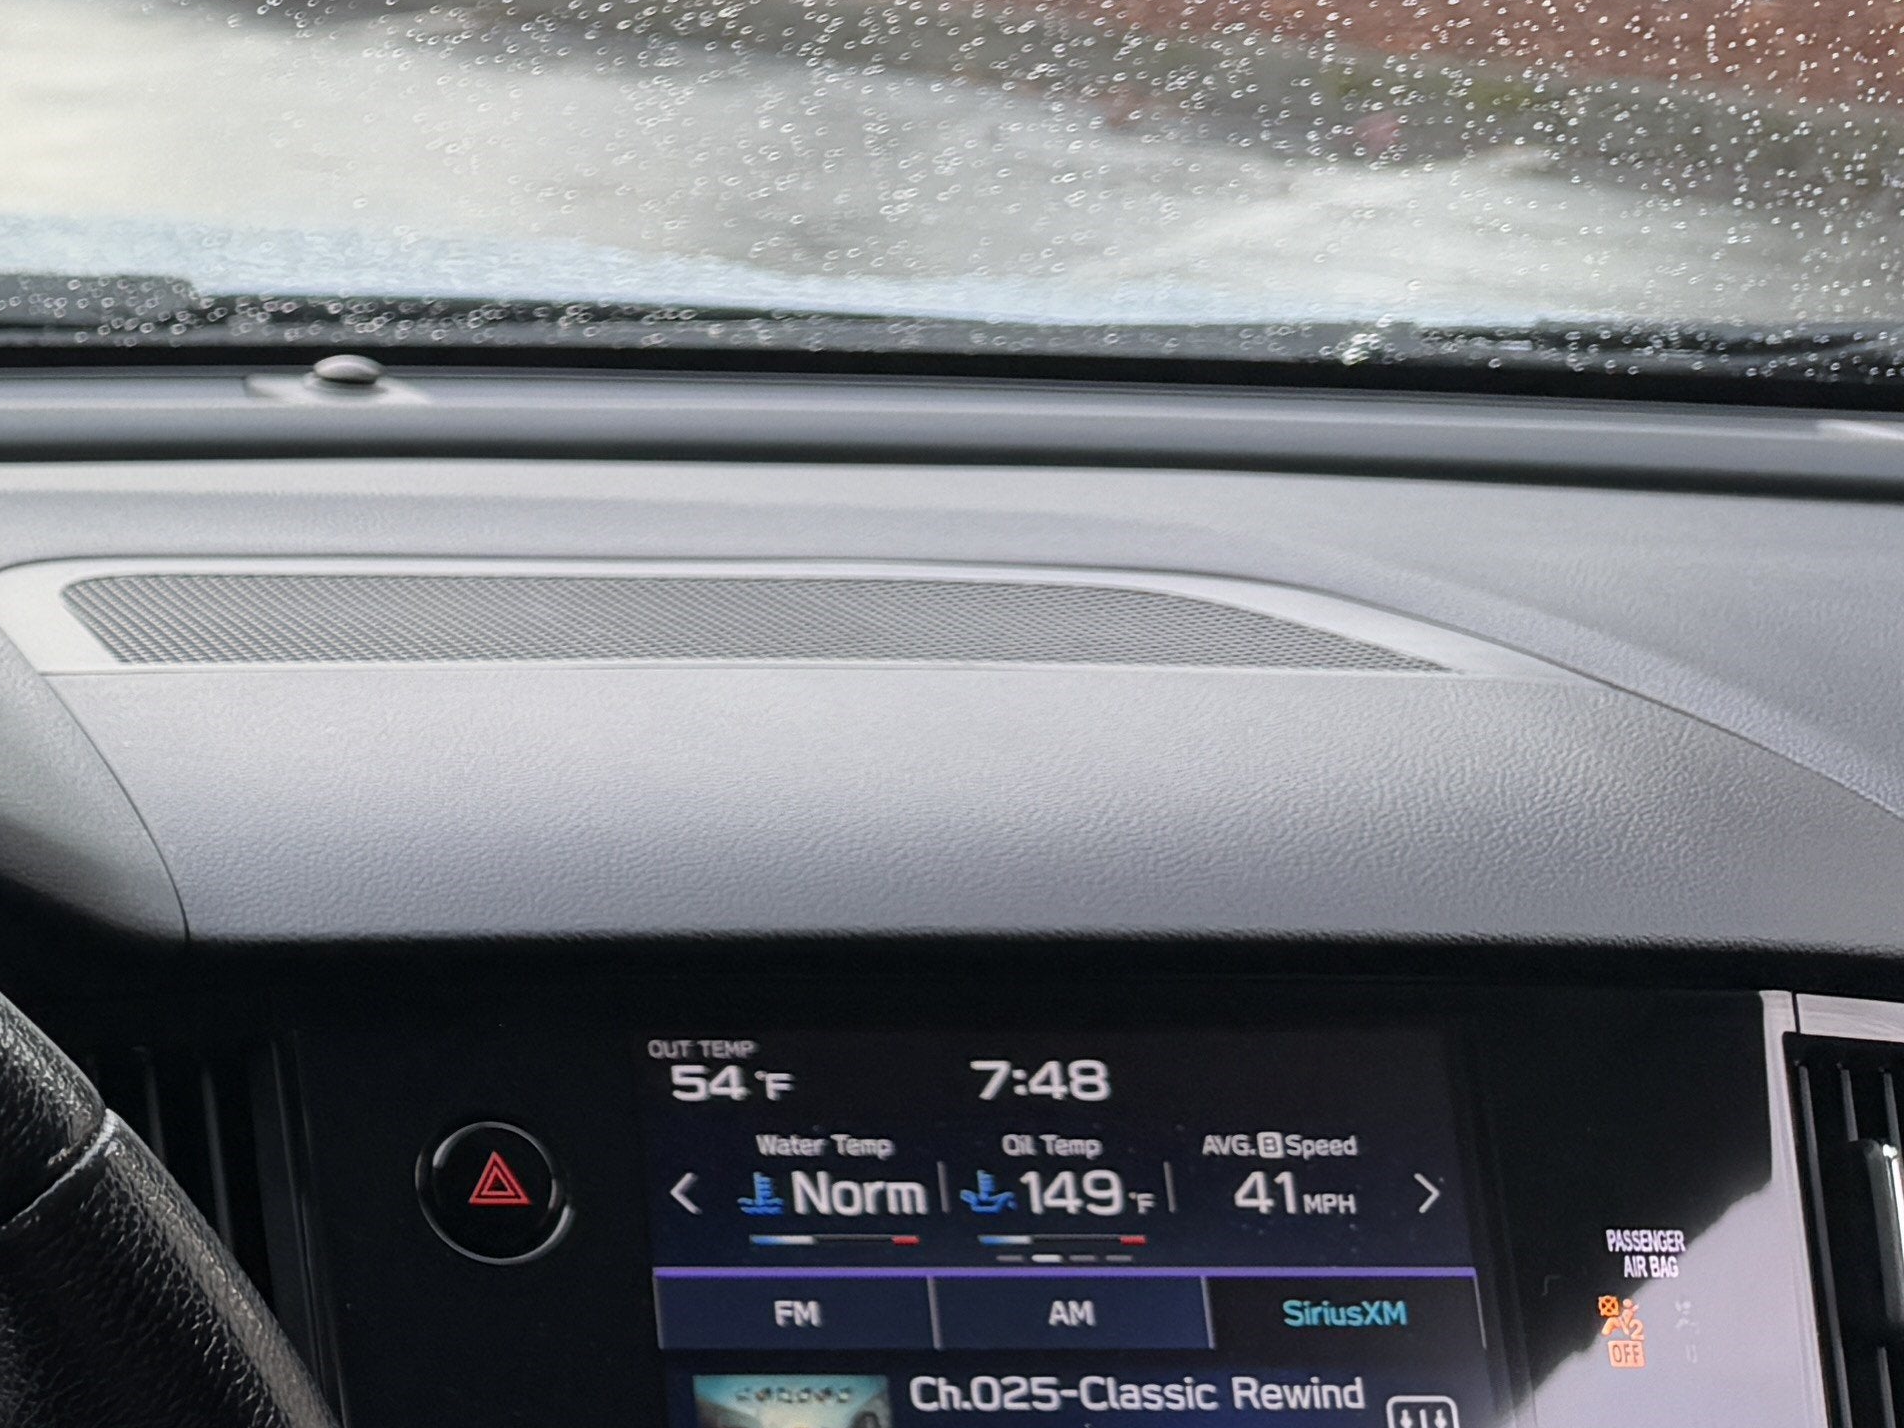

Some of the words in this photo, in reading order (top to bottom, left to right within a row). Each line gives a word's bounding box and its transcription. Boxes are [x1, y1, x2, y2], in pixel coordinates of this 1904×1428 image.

[648, 1040, 692, 1059] OUT
[697, 1040, 758, 1059] TEMP
[671, 1065, 749, 1101] 54
[969, 1060, 1111, 1101] 7:48
[756, 1134, 828, 1156] Water
[831, 1134, 896, 1160] Temp
[1002, 1134, 1037, 1157] Oil
[1042, 1134, 1102, 1159] Temp
[1285, 1134, 1357, 1159] Speed
[793, 1171, 927, 1216] Norm
[1020, 1171, 1127, 1216] 149
[1234, 1171, 1299, 1215] 41
[1303, 1193, 1357, 1215] MPH
[1605, 1229, 1686, 1252] PASSENGER
[1624, 1256, 1648, 1278] AIR
[1649, 1256, 1679, 1278] BAG
[774, 1301, 823, 1327] FM
[1049, 1301, 1097, 1327] AM
[1282, 1300, 1407, 1327] SiriusXM
[1612, 1344, 1640, 1363] OFF
[910, 1377, 1218, 1412] Ch.025-Classic
[1233, 1377, 1365, 1412] Rewind
